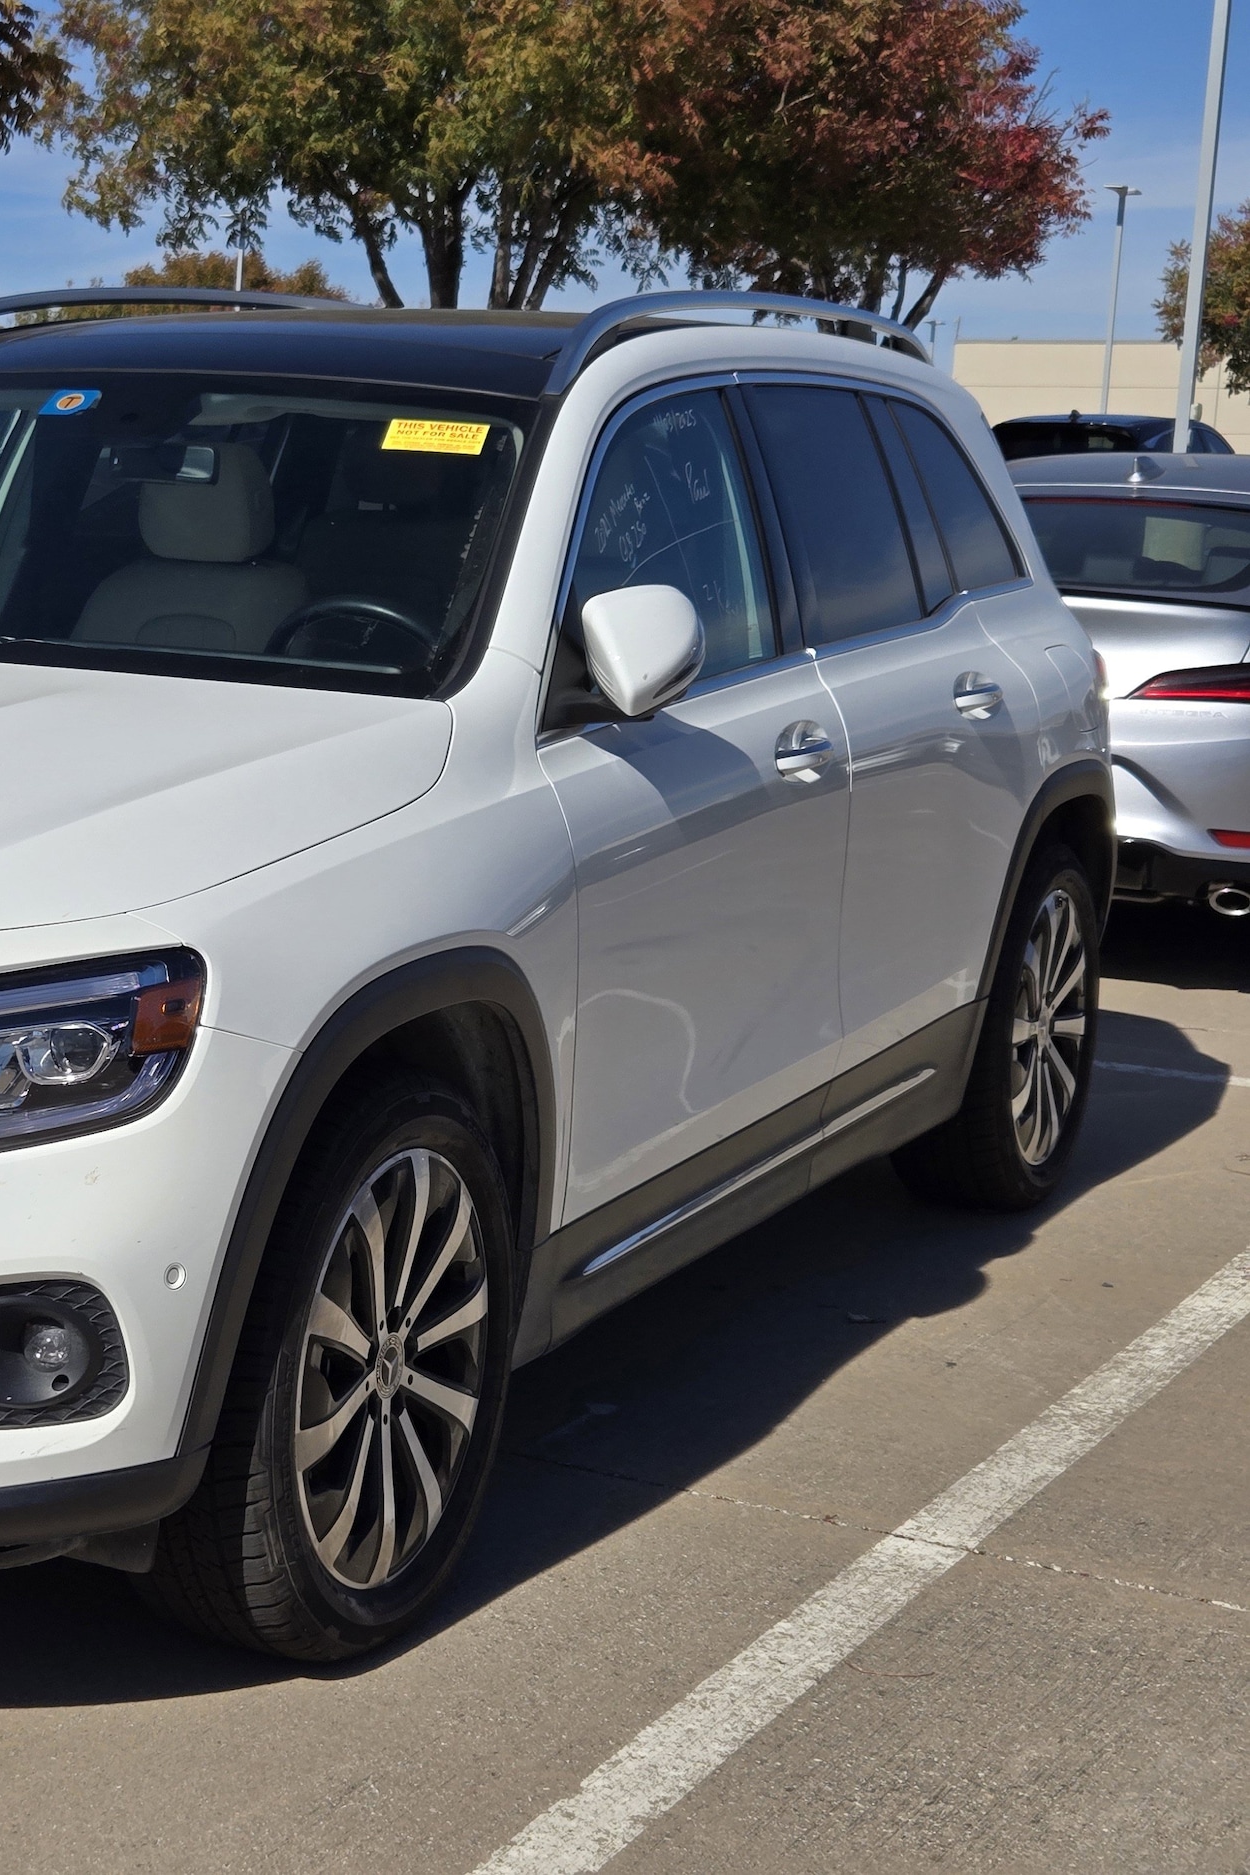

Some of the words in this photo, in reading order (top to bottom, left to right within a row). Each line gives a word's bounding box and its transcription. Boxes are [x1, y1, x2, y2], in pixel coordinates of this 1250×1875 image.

[396, 421, 425, 430] THIS
[429, 423, 484, 434] VEHICLE
[449, 432, 480, 440] SALE
[1139, 708, 1230, 720] INTEGRA
